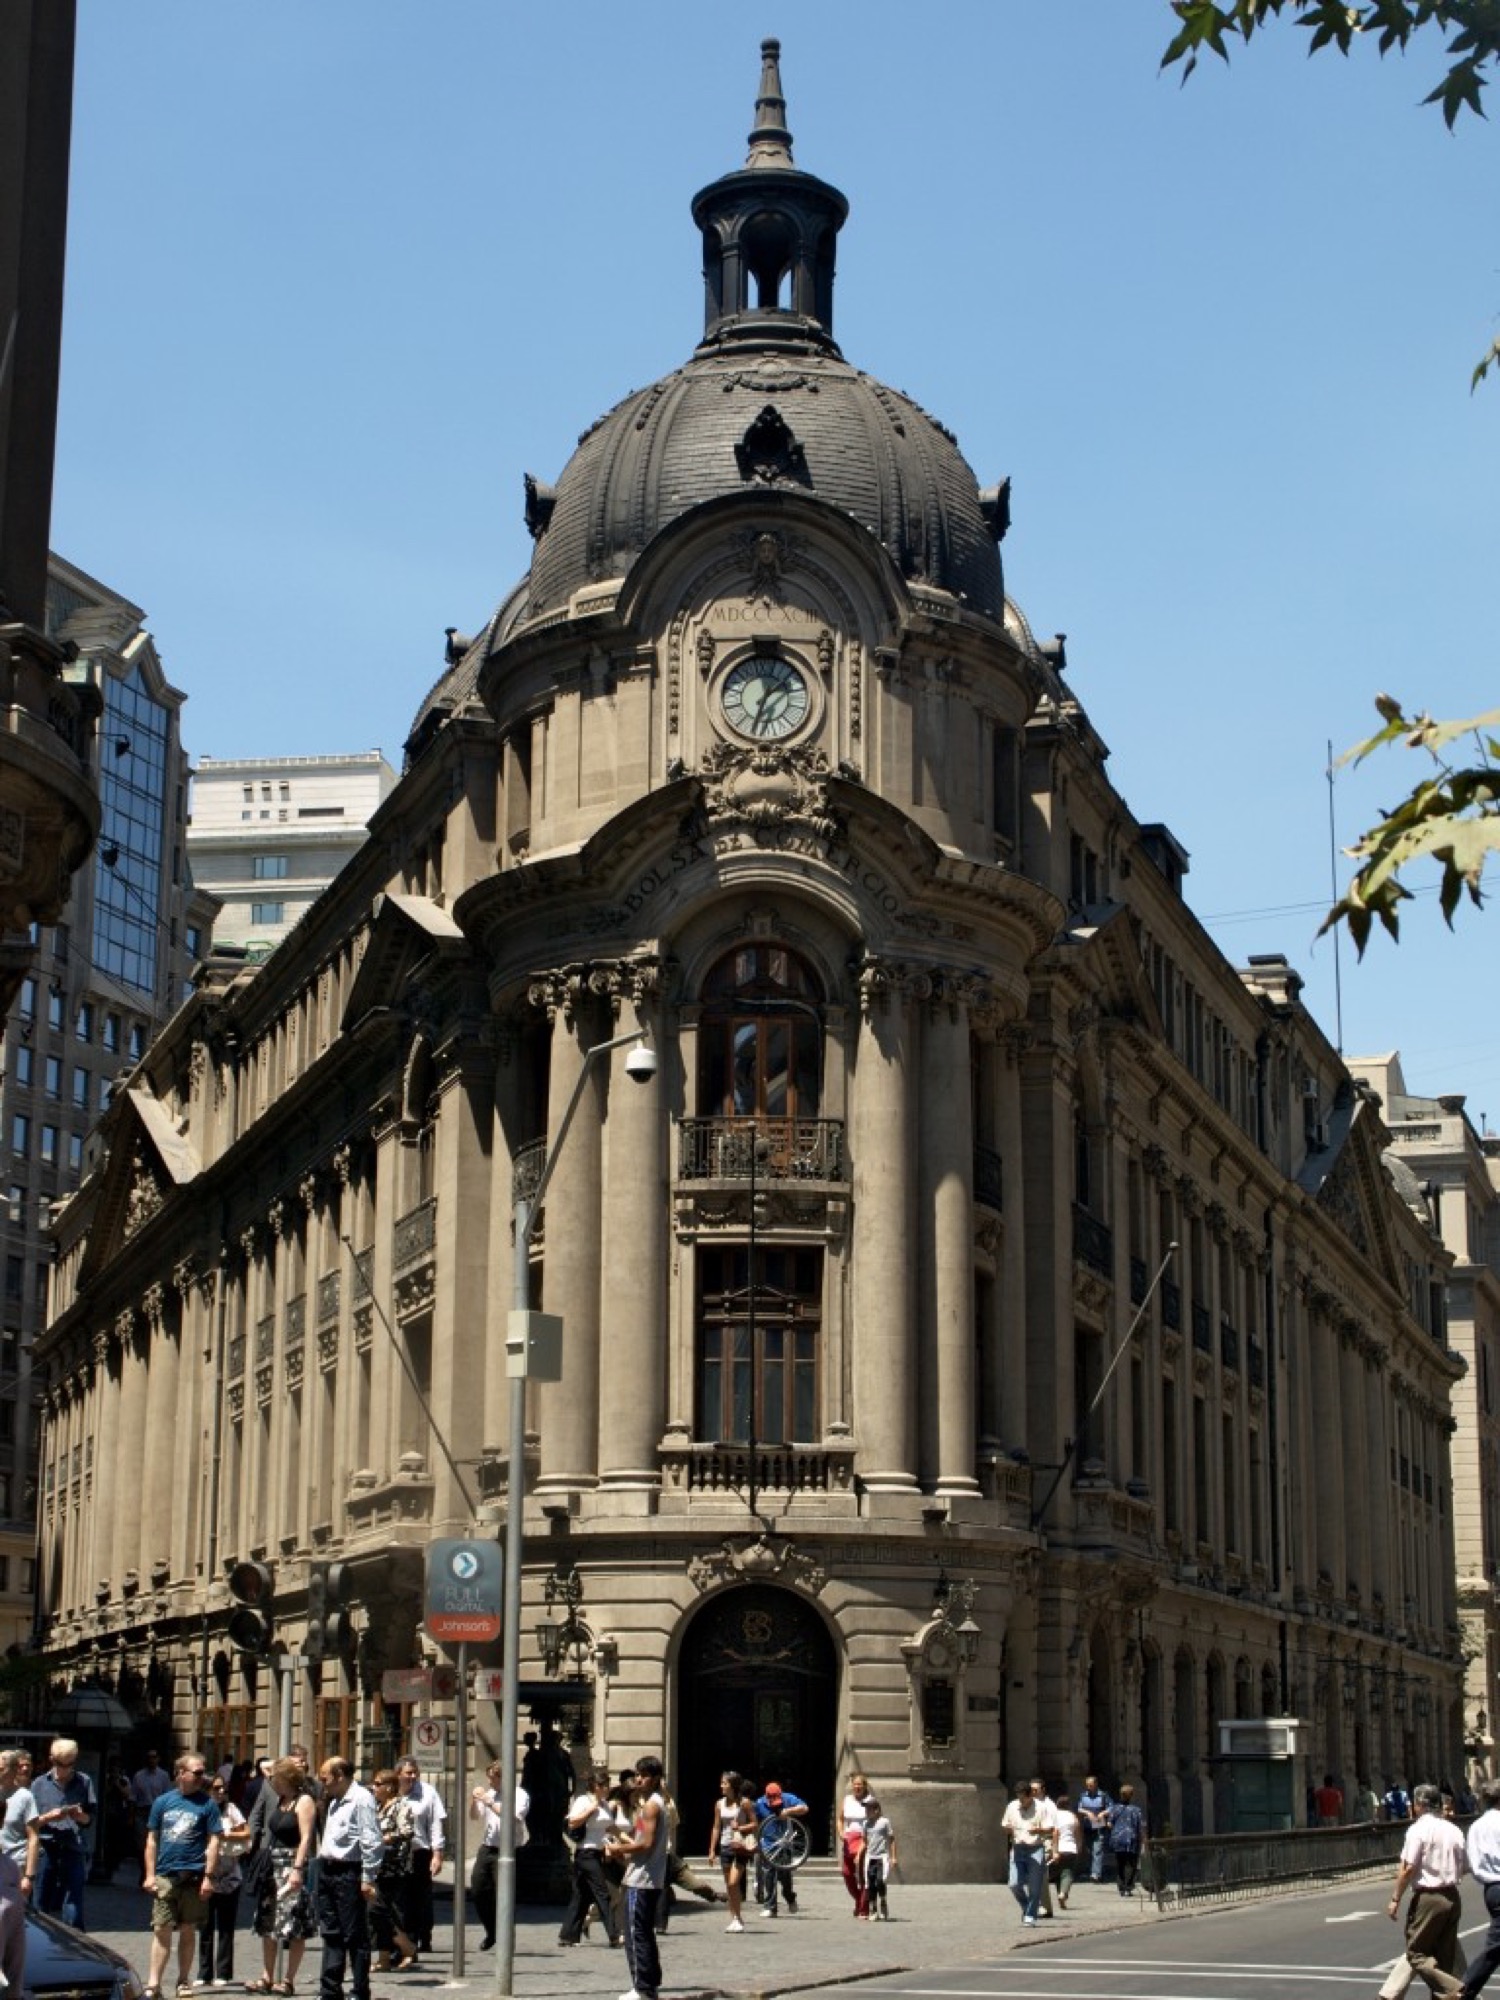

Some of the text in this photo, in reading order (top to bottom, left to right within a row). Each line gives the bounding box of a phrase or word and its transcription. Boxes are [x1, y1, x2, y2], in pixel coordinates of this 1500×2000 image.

[624, 839, 709, 912] BOLSA
[716, 836, 743, 854] DE
[443, 1585, 484, 1602] FULL
[444, 1601, 485, 1612] DIGITAL
